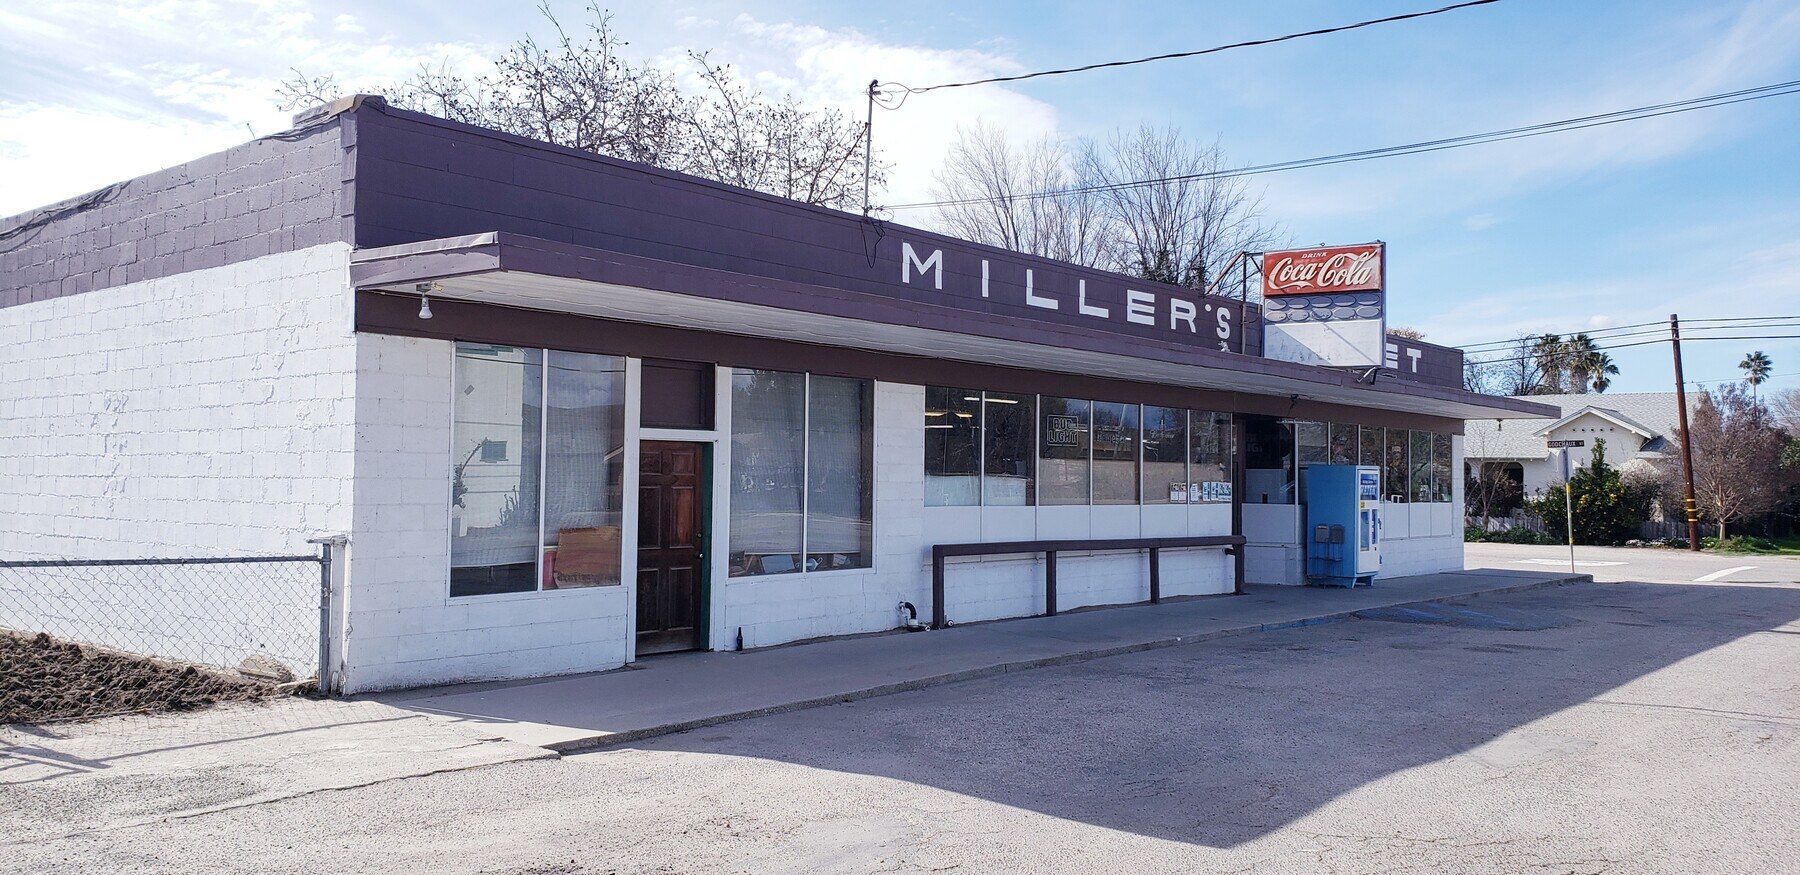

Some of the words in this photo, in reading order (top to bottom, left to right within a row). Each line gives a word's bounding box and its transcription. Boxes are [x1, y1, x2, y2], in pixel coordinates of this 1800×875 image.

[1268, 249, 1378, 289] Coca-Cola
[1053, 418, 1073, 430] BUD
[1048, 430, 1077, 443] LIGHT
